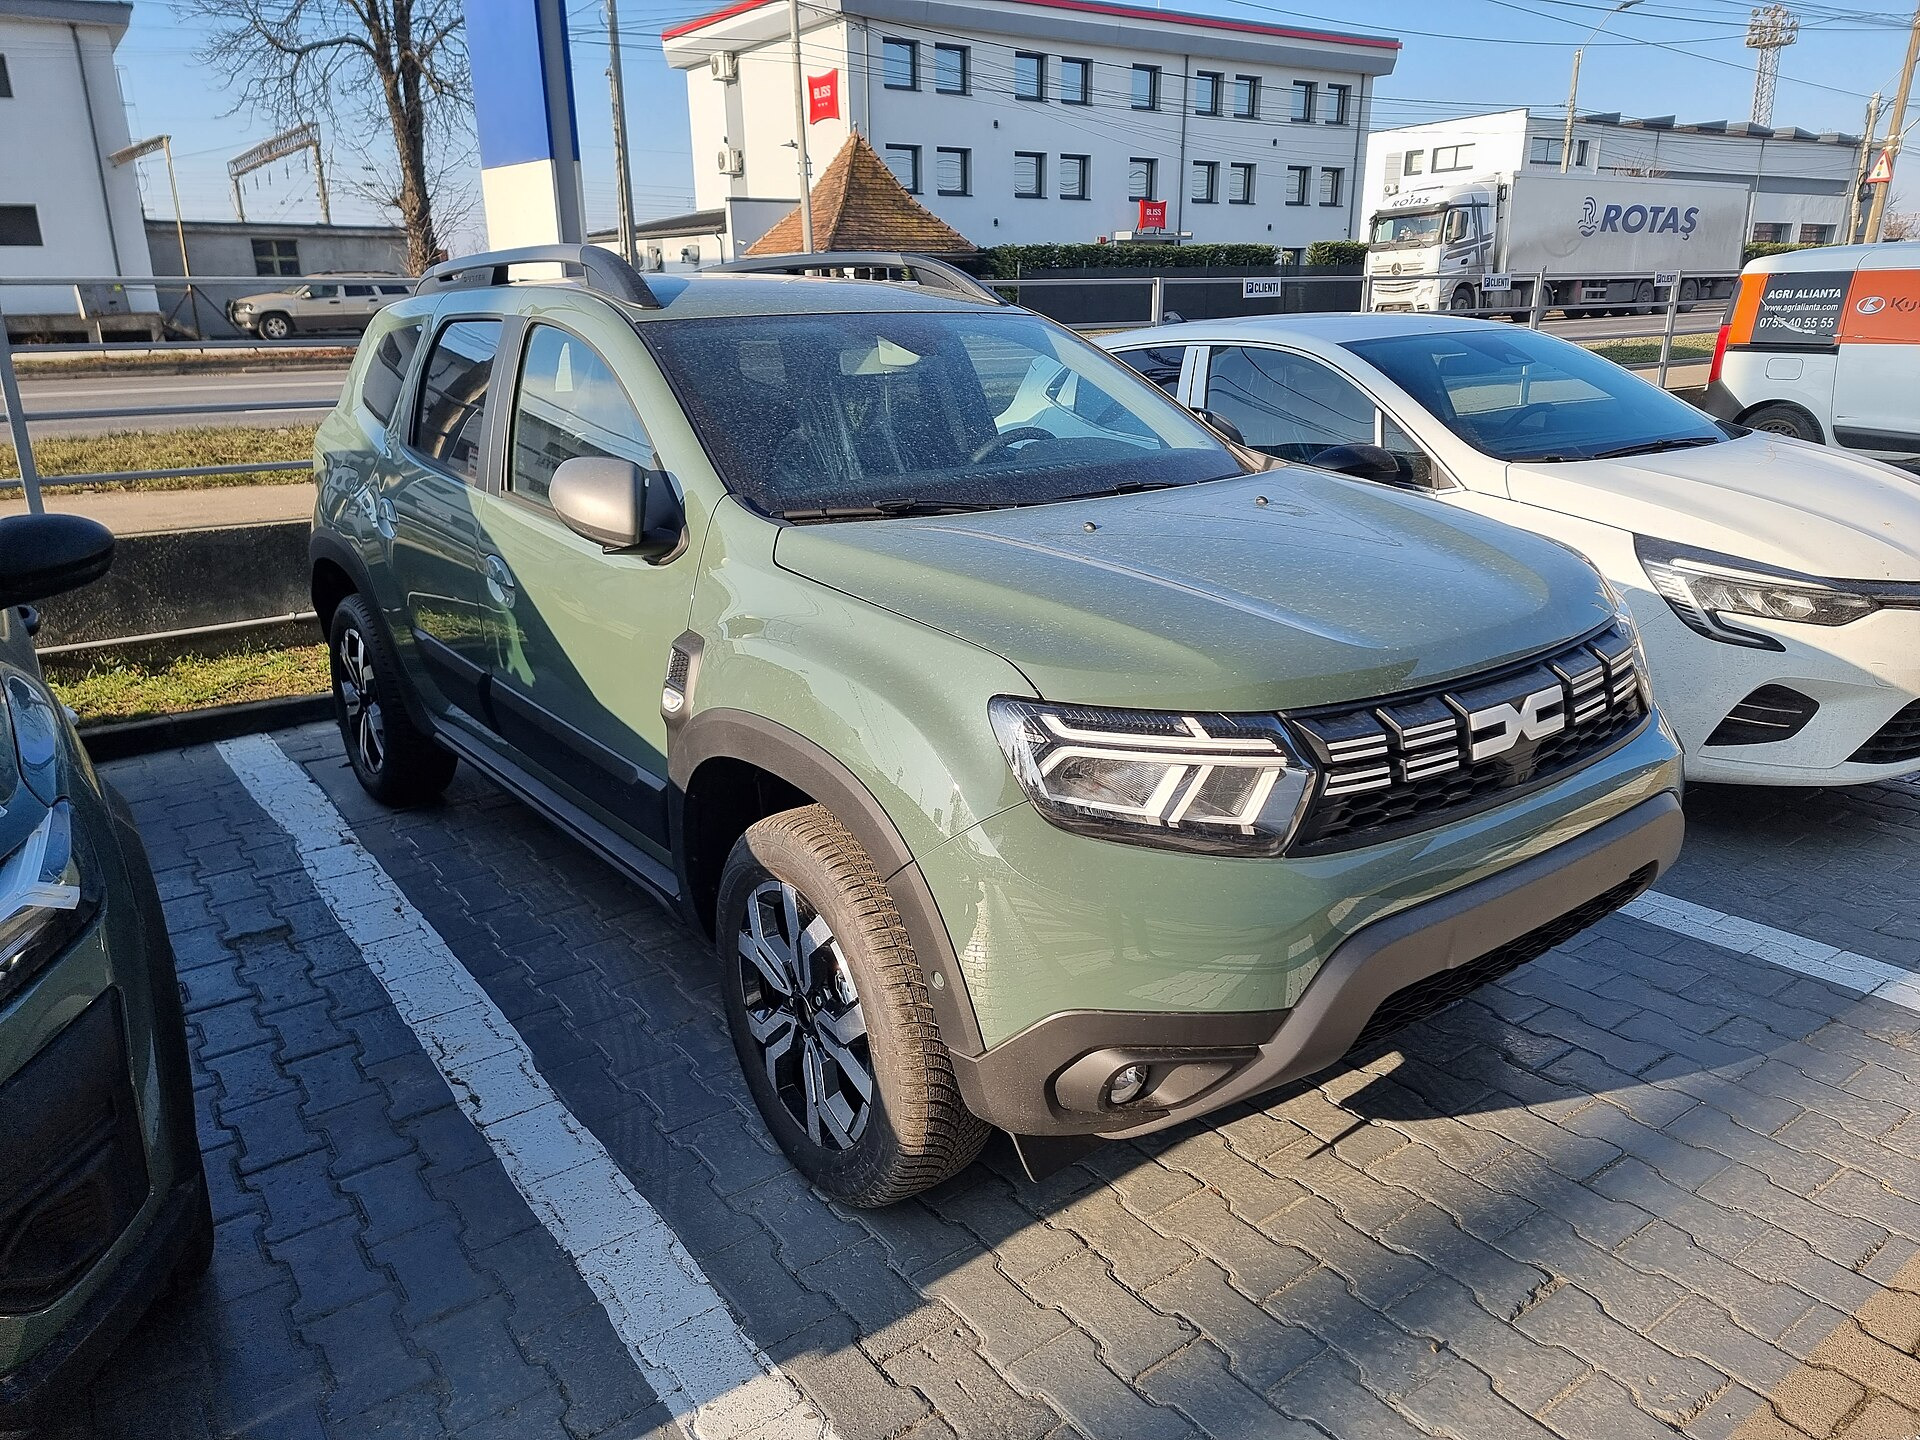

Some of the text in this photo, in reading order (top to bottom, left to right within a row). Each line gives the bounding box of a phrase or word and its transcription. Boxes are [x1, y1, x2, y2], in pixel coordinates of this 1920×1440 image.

[813, 85, 831, 100] BLISS
[1146, 208, 1162, 216] BLISS
[1600, 204, 1700, 241] ROTAŞ
[1767, 288, 1841, 299] AGRI ALIANTA
[1764, 302, 1838, 313] www.agrialianta.com
[1759, 317, 1835, 328] 0755 40 55 55
